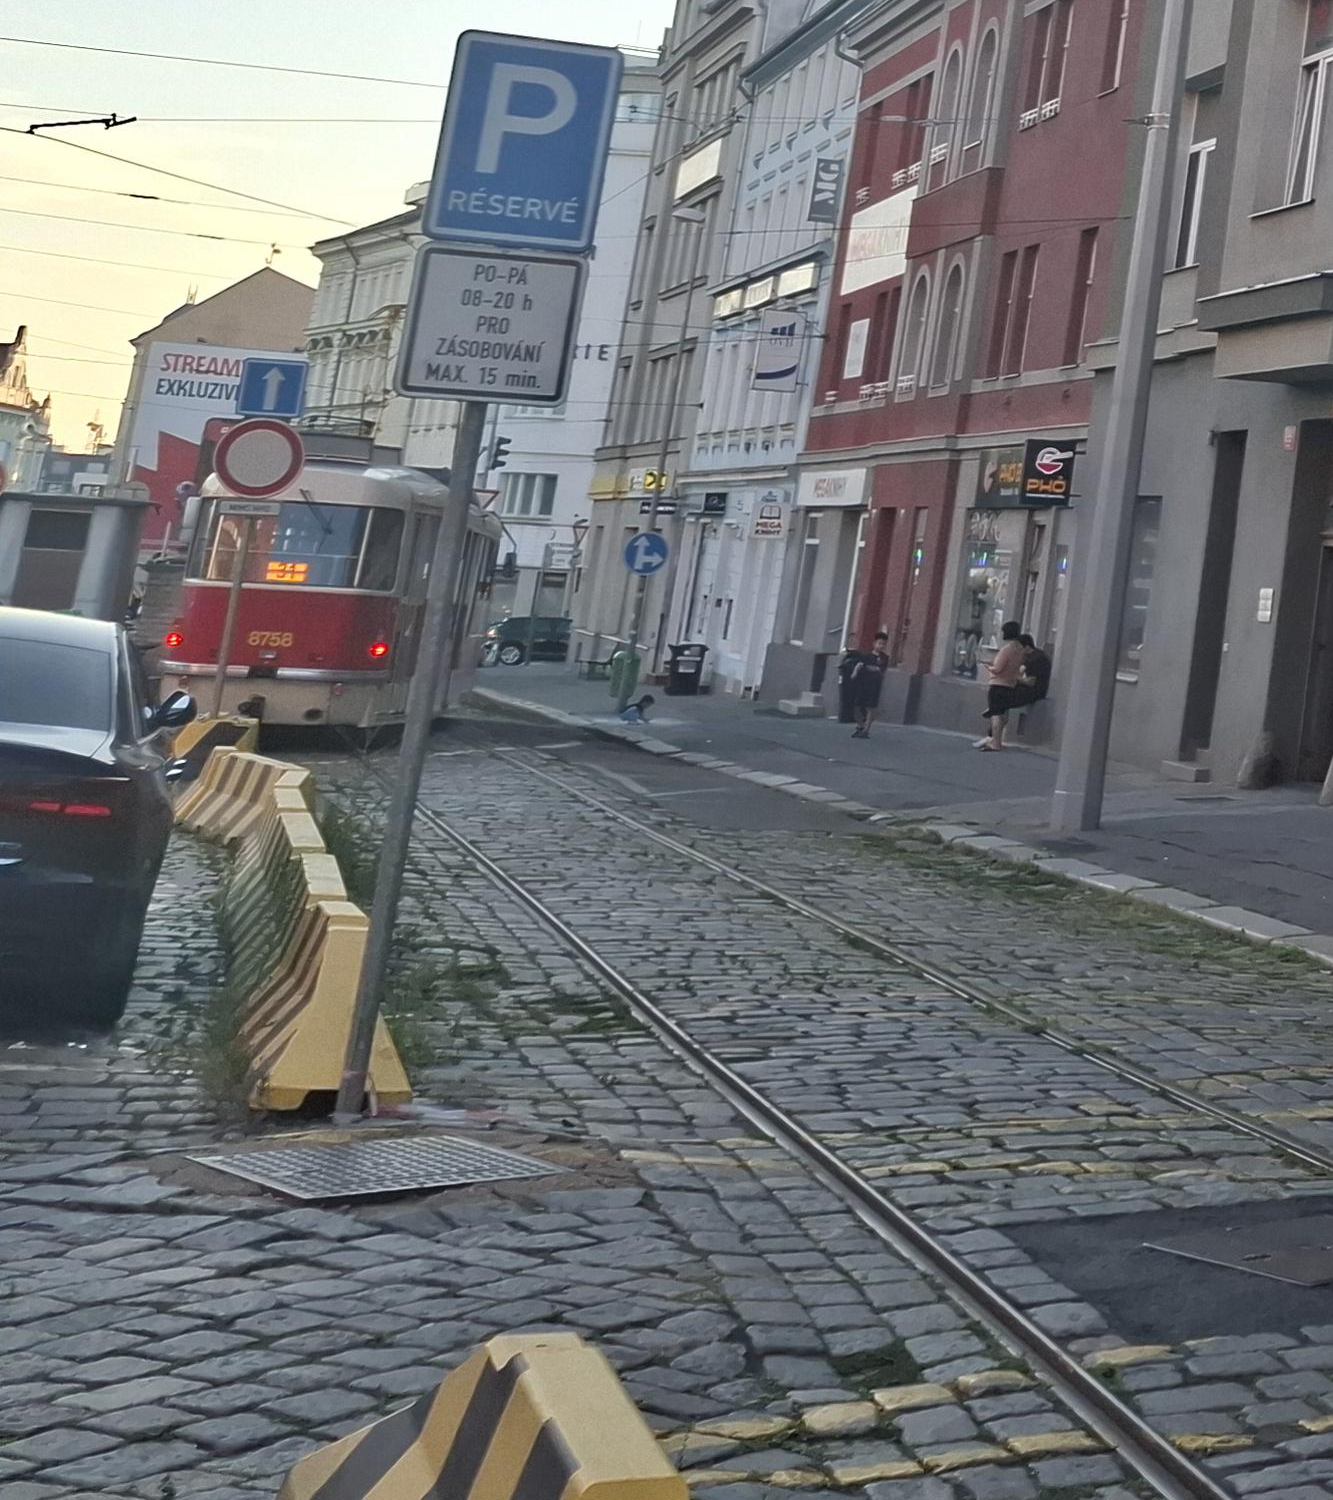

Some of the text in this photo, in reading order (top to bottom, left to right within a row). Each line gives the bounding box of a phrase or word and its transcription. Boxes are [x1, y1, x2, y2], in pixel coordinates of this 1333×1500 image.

[475, 62, 578, 174] P
[447, 189, 580, 224] RÉSERVÉ
[473, 264, 528, 287] PO-PÁ
[460, 289, 533, 311] 08-20 h
[475, 316, 510, 336] PRO
[434, 336, 546, 364] ZÁSOBOVÁNÍ
[574, 343, 609, 361] IE
[425, 363, 541, 389] MAX. 15 min.
[248, 631, 294, 648] 8758
